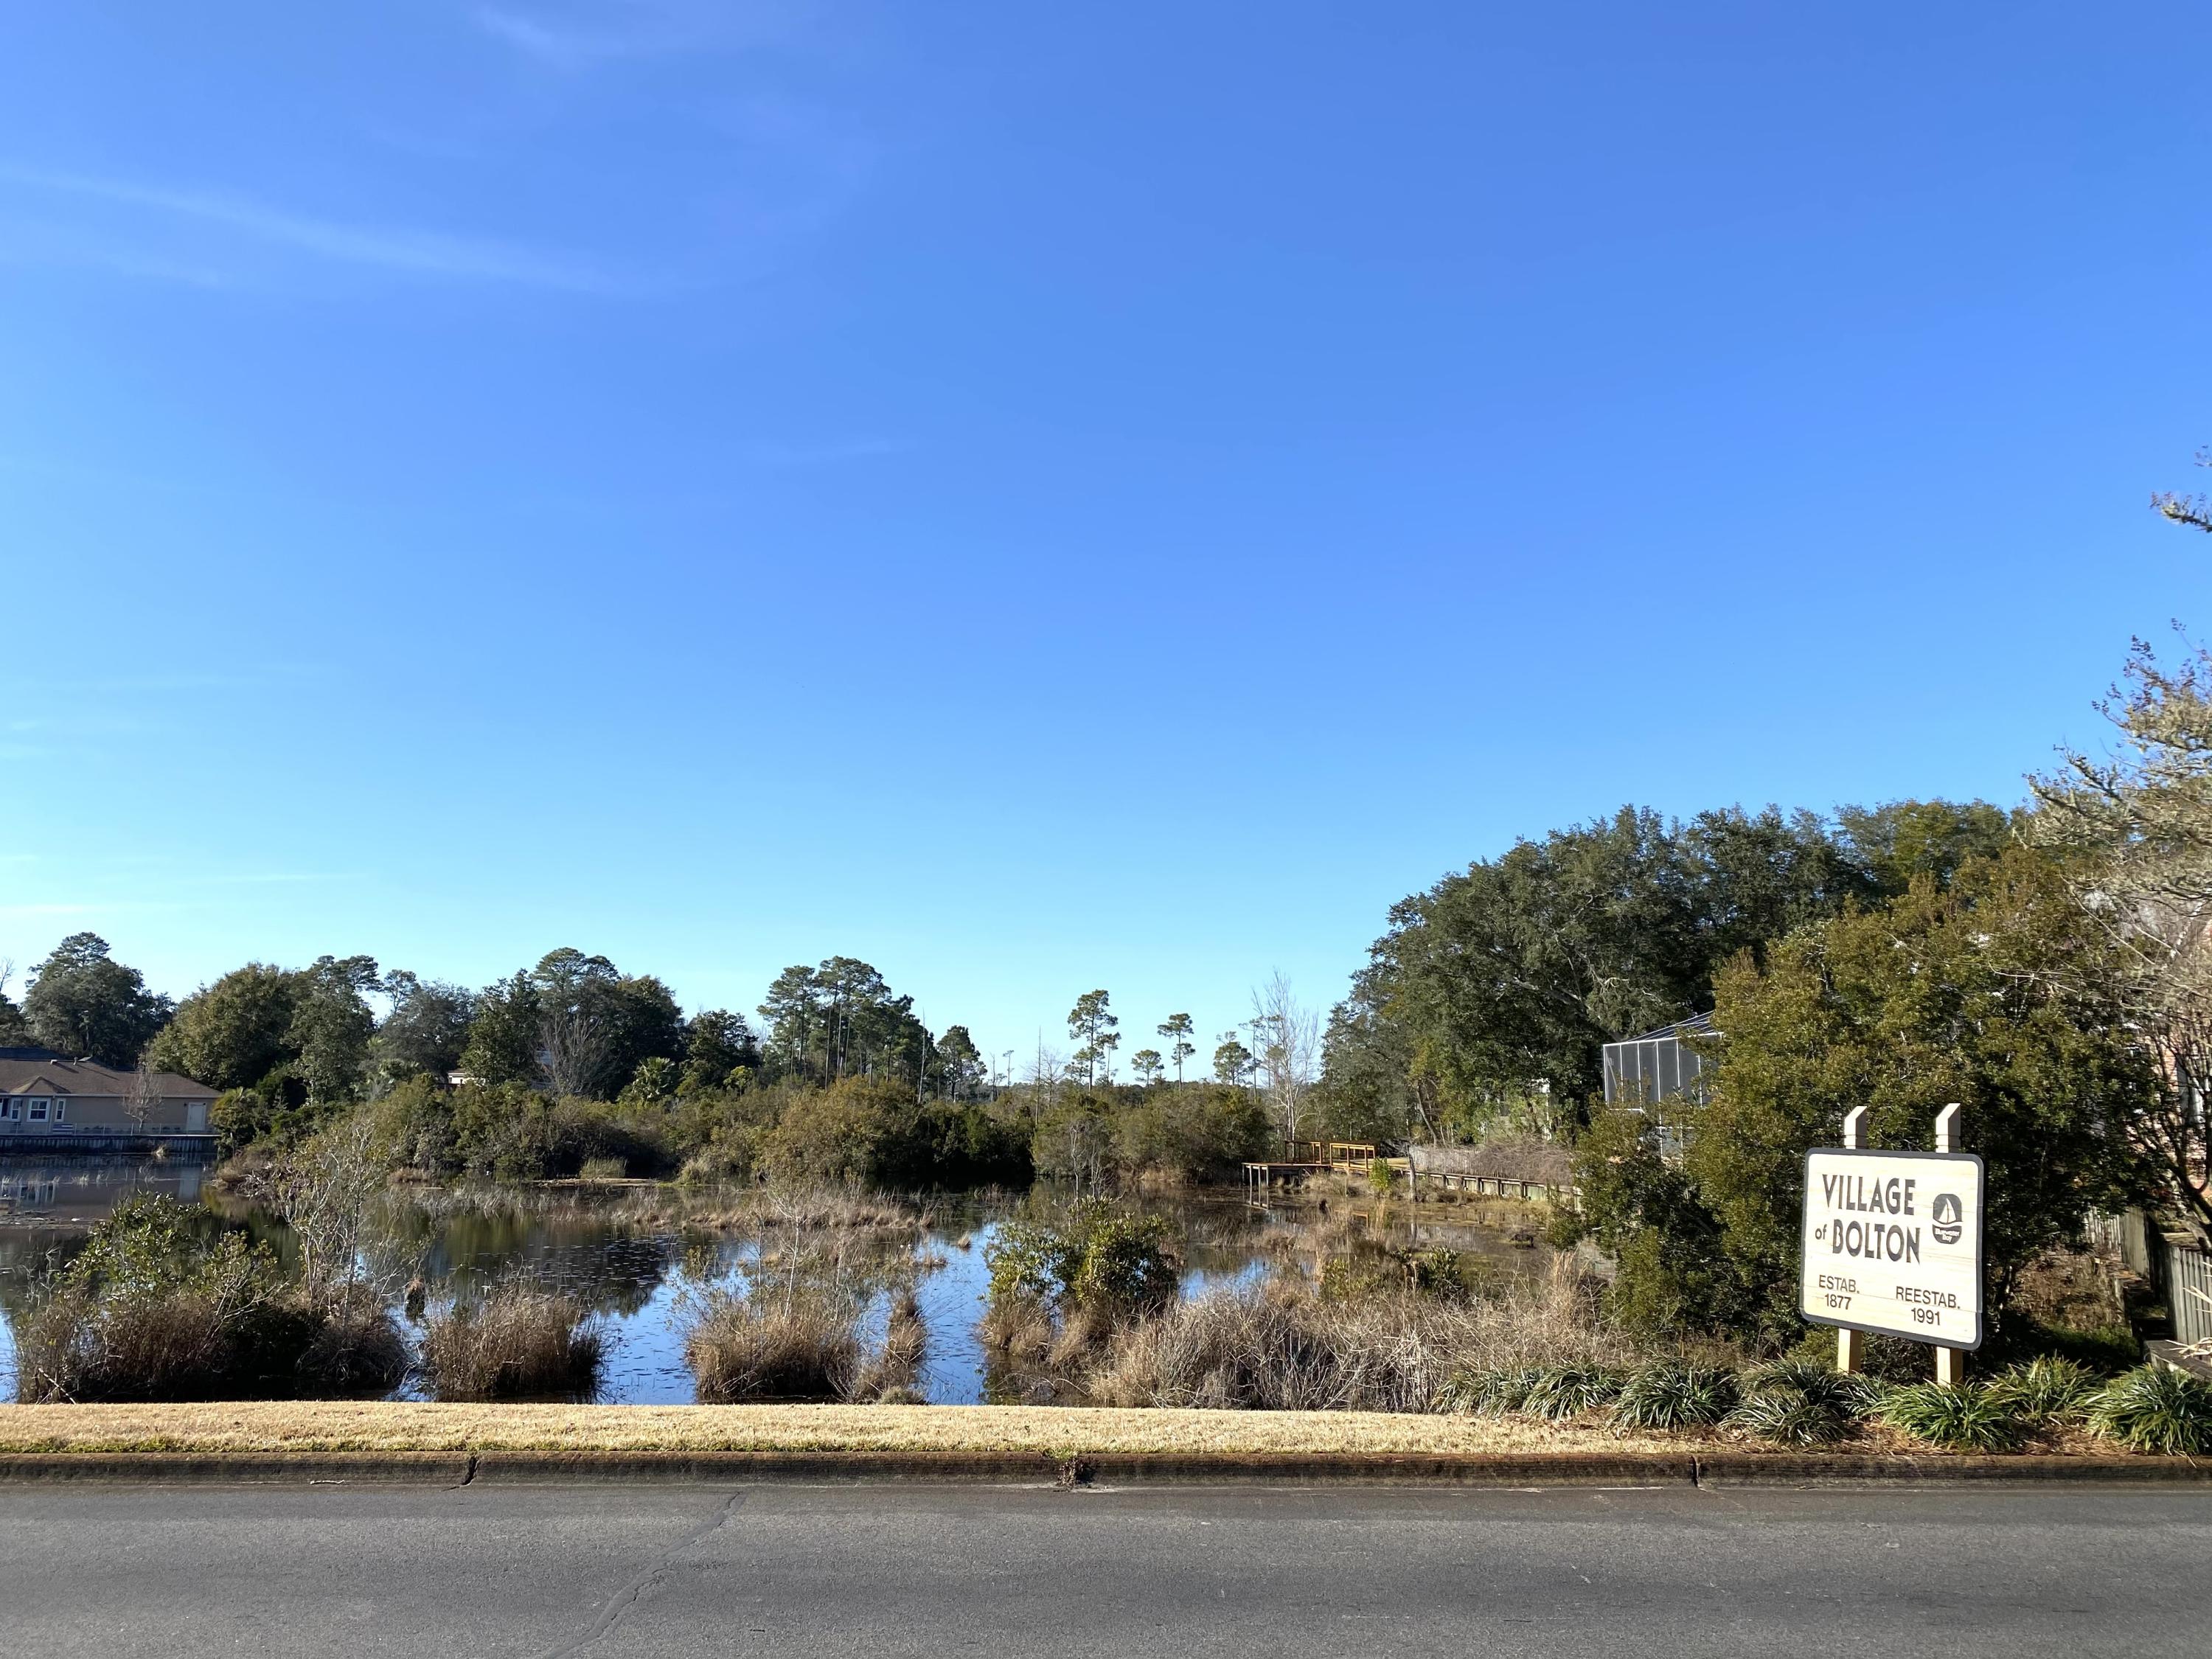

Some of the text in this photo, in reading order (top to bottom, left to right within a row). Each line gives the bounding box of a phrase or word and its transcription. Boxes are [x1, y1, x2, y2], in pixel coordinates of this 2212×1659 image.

[1822, 1174, 1916, 1215] VILLAGE
[1815, 1219, 1921, 1265] of BOLTON
[1818, 1274, 1860, 1294] ESTAB.
[1824, 1293, 1851, 1310] 1877
[1896, 1286, 1961, 1310] REESTAB.
[1911, 1307, 1941, 1326] 1991
